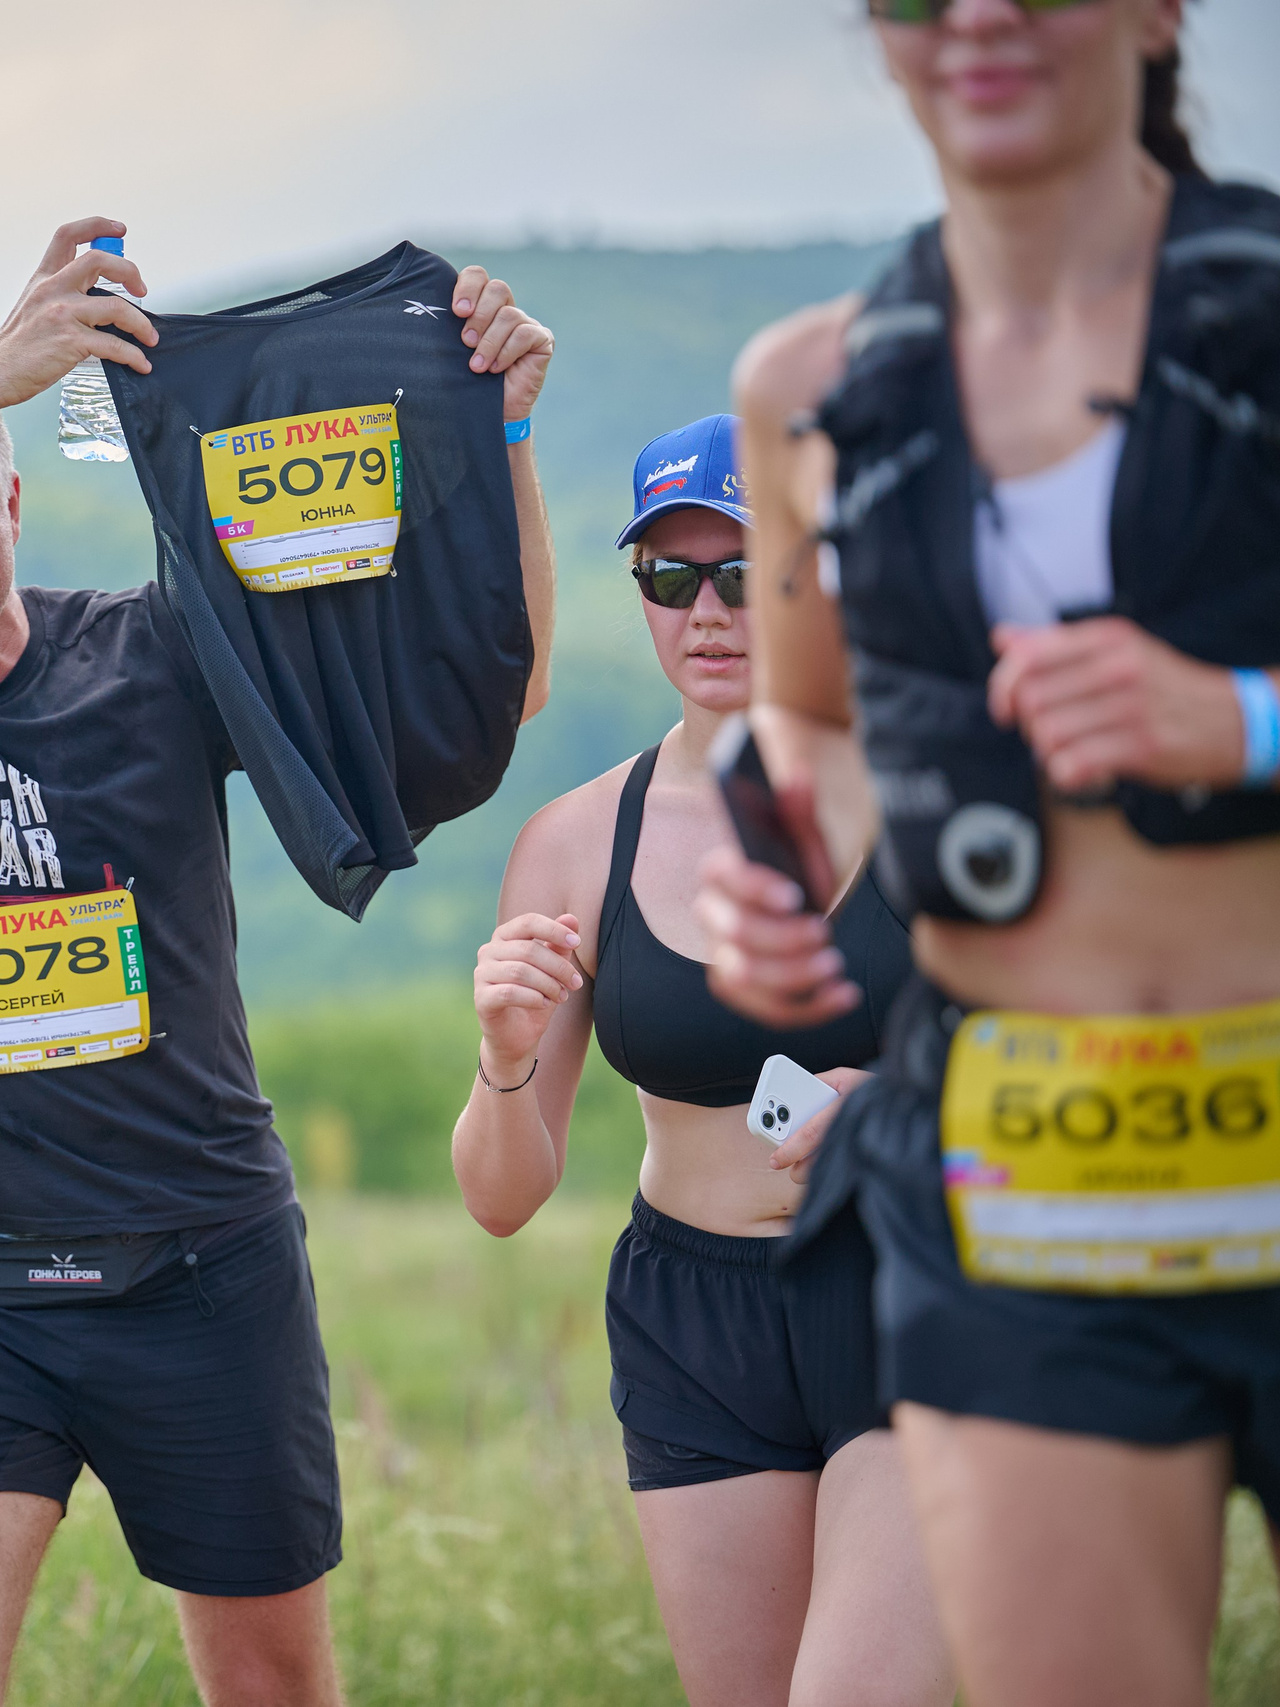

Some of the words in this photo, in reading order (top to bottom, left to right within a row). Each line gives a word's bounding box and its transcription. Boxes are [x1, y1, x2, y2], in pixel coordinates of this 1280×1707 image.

[232, 430, 275, 455] ВТБ
[285, 417, 359, 446] ЛУКА
[359, 413, 391, 425] УЛЬТРА
[238, 447, 386, 504] 5079
[392, 443, 401, 507] ТРЕЙЛ
[300, 504, 356, 522] ЮННА
[69, 899, 122, 916] УЛЬТРА
[123, 928, 142, 991] ТРЕЙЛ
[989, 1075, 1268, 1146] 5036
[28, 1269, 62, 1279] ГОНКА
[64, 1269, 102, 1280] ГЕРОЕВ
